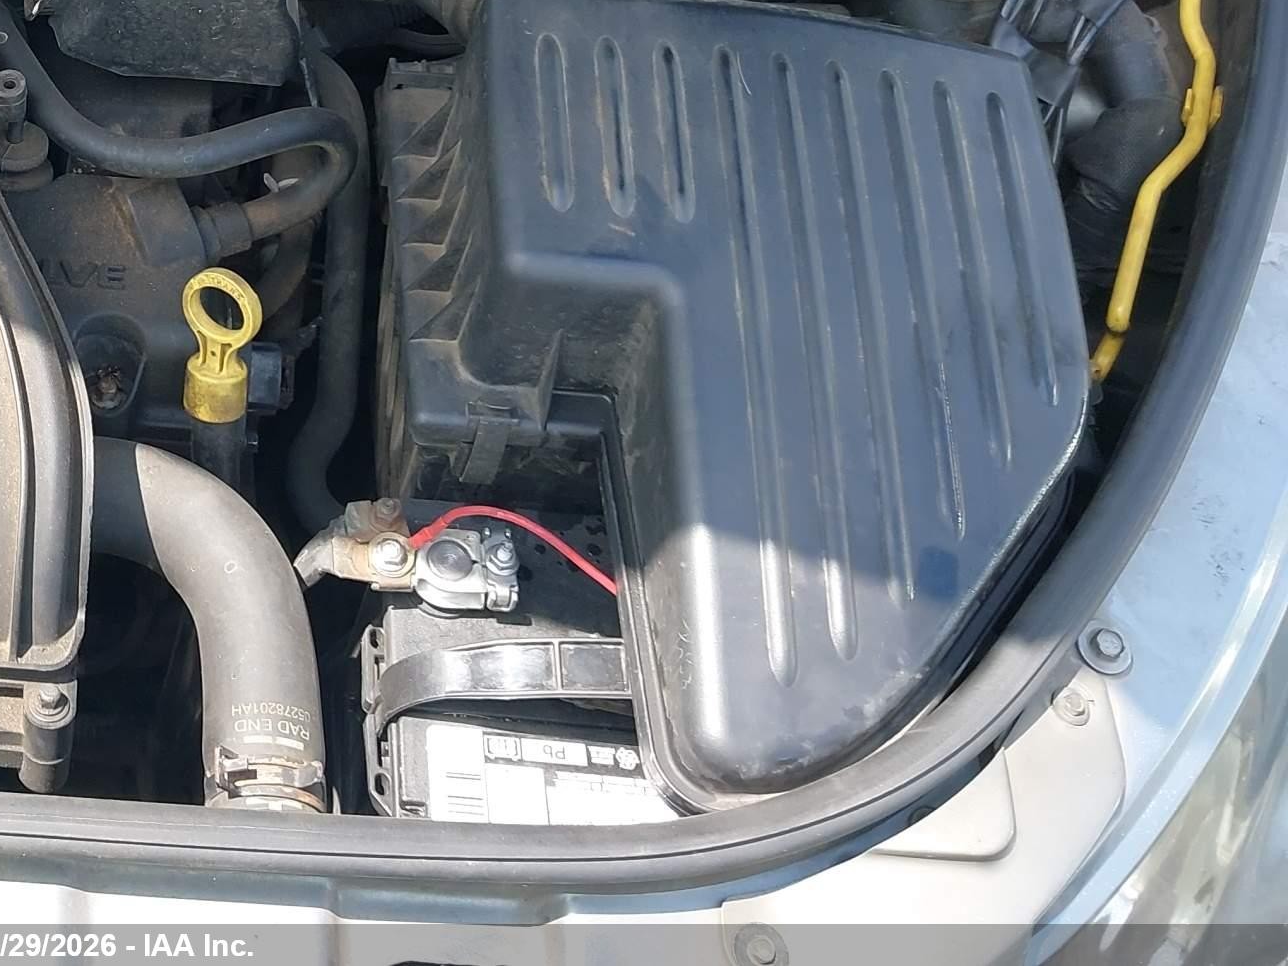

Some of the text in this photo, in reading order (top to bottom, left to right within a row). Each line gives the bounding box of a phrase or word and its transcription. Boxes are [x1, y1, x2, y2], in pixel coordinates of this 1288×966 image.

[234, 718, 310, 740] RAD END
[543, 744, 566, 760] Pb
